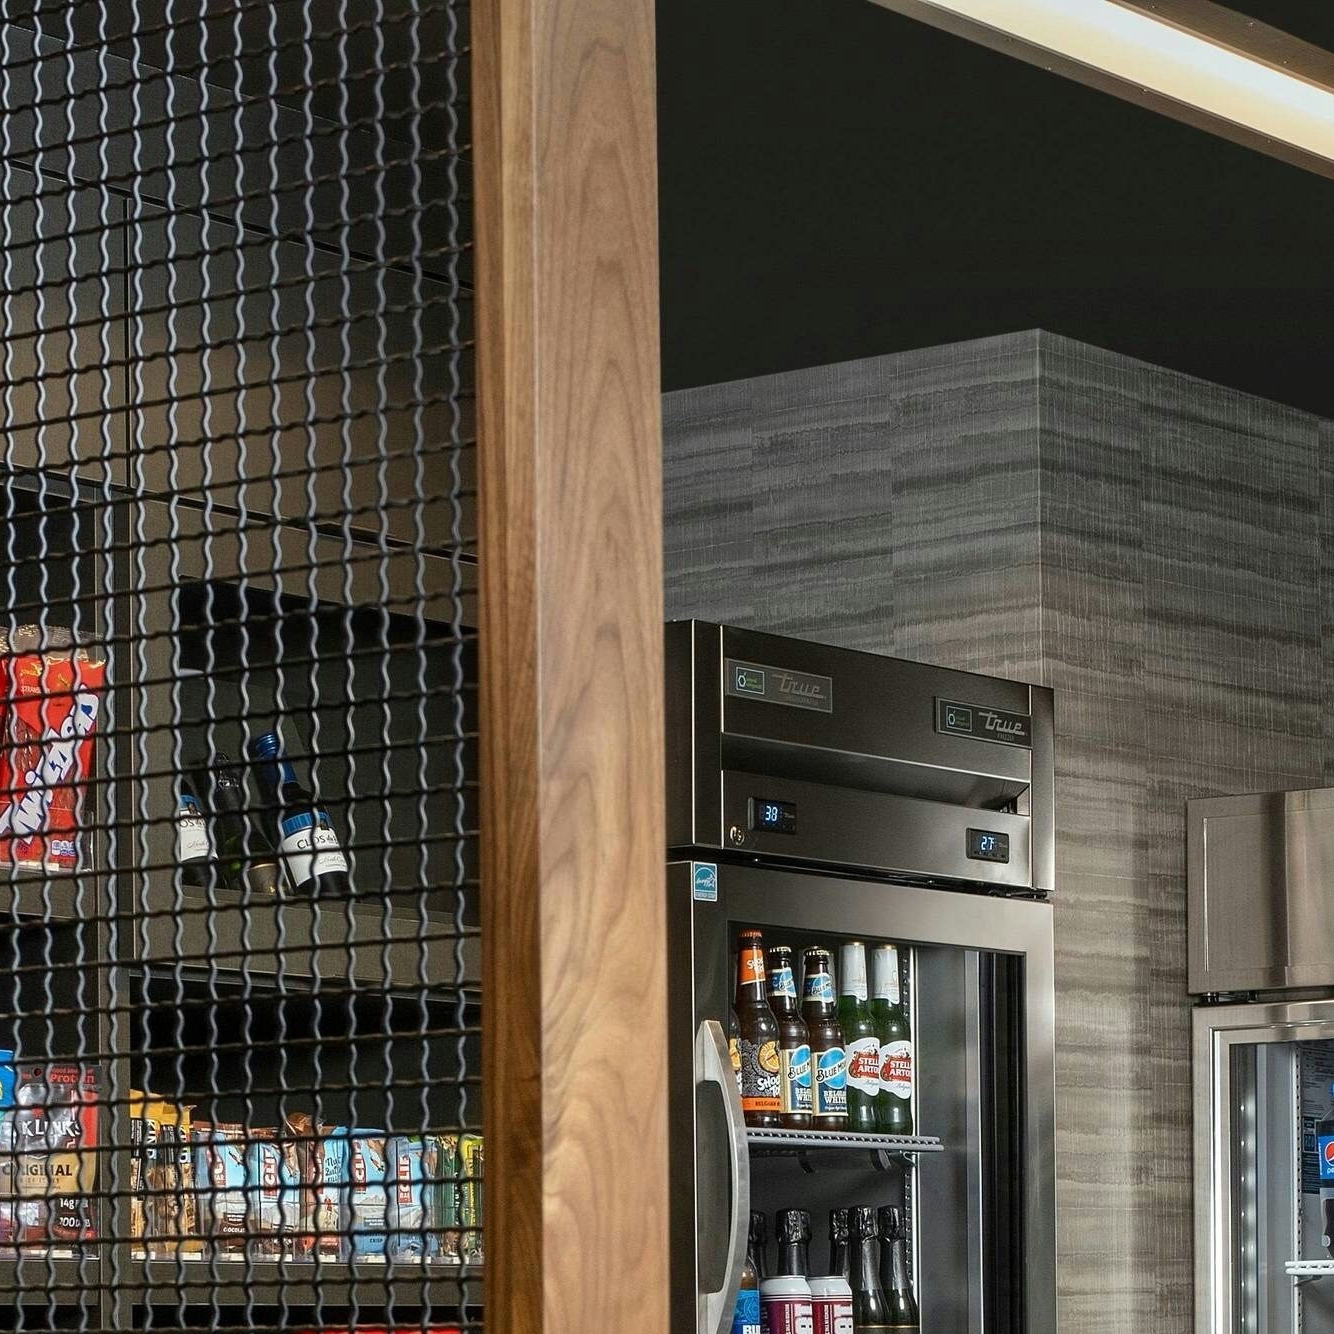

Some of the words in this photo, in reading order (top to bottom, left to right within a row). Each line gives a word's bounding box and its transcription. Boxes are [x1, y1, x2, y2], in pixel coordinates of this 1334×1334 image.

[764, 805, 778, 821] 38
[858, 1057, 879, 1066] STELL
[890, 1060, 911, 1069] STELL
[857, 1065, 879, 1074] ARTO
[889, 1068, 911, 1077] ARTO
[50, 1074, 95, 1084] Protin
[757, 1074, 781, 1092] SHOC
[771, 1086, 781, 1098] TO
[824, 1097, 847, 1105] WHIT
